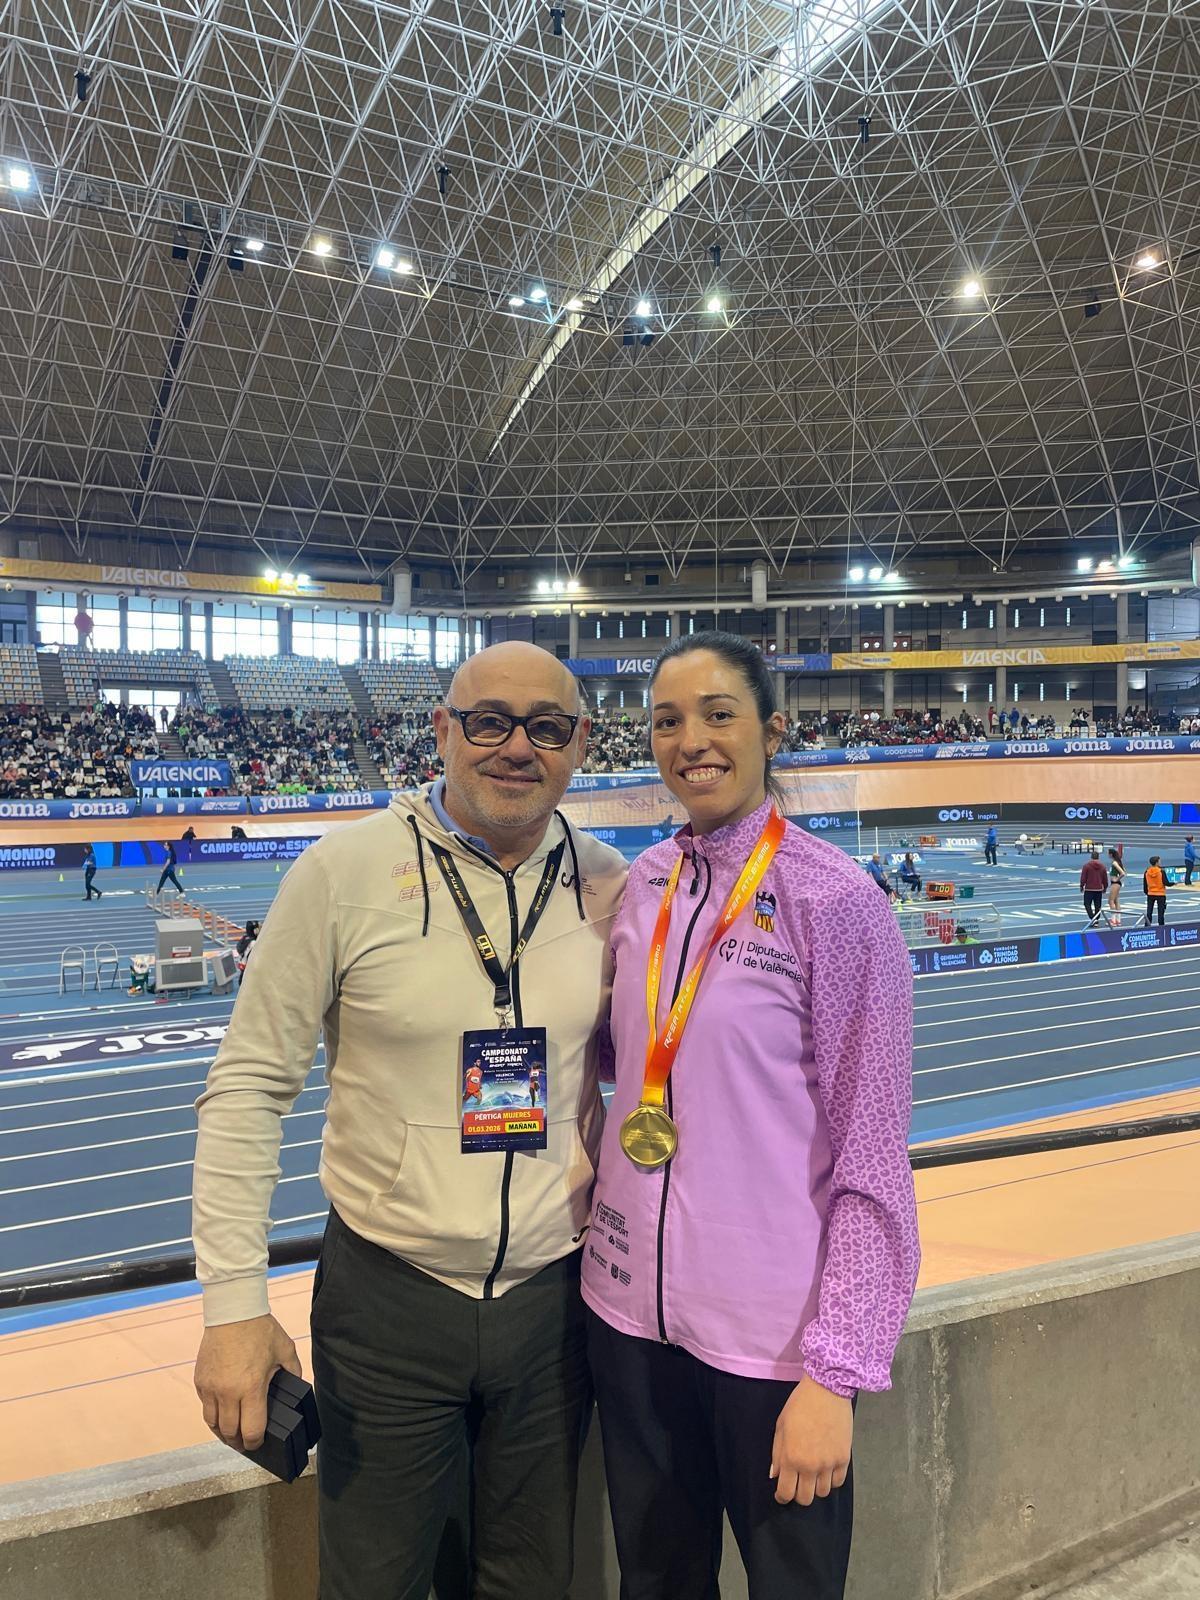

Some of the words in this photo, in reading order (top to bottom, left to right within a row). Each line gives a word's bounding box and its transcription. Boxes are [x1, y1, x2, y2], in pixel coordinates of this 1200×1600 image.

[102, 566, 190, 587] VALENCIA
[962, 648, 1046, 665] VALENCIA
[616, 659, 656, 673] VALE
[1004, 743, 1050, 756] Joma
[1064, 740, 1112, 754] Joma
[1126, 739, 1175, 752] Joma
[138, 766, 222, 783] VALENCIA
[259, 795, 310, 813] Joma
[325, 792, 374, 809] Joma
[0, 803, 51, 817] oma
[69, 802, 129, 818] Joma
[201, 841, 278, 854] CAMPEONATO
[741, 842, 771, 896] ATLETISMO
[994, 956, 1019, 964] ALFONSO
[743, 956, 758, 968] de
[760, 958, 802, 983] València
[481, 1047, 528, 1056] CAMPEONATO
[489, 1054, 523, 1064] ESPAÑA
[502, 1111, 531, 1119] MUJERES
[508, 1122, 537, 1130] MAÑANA
